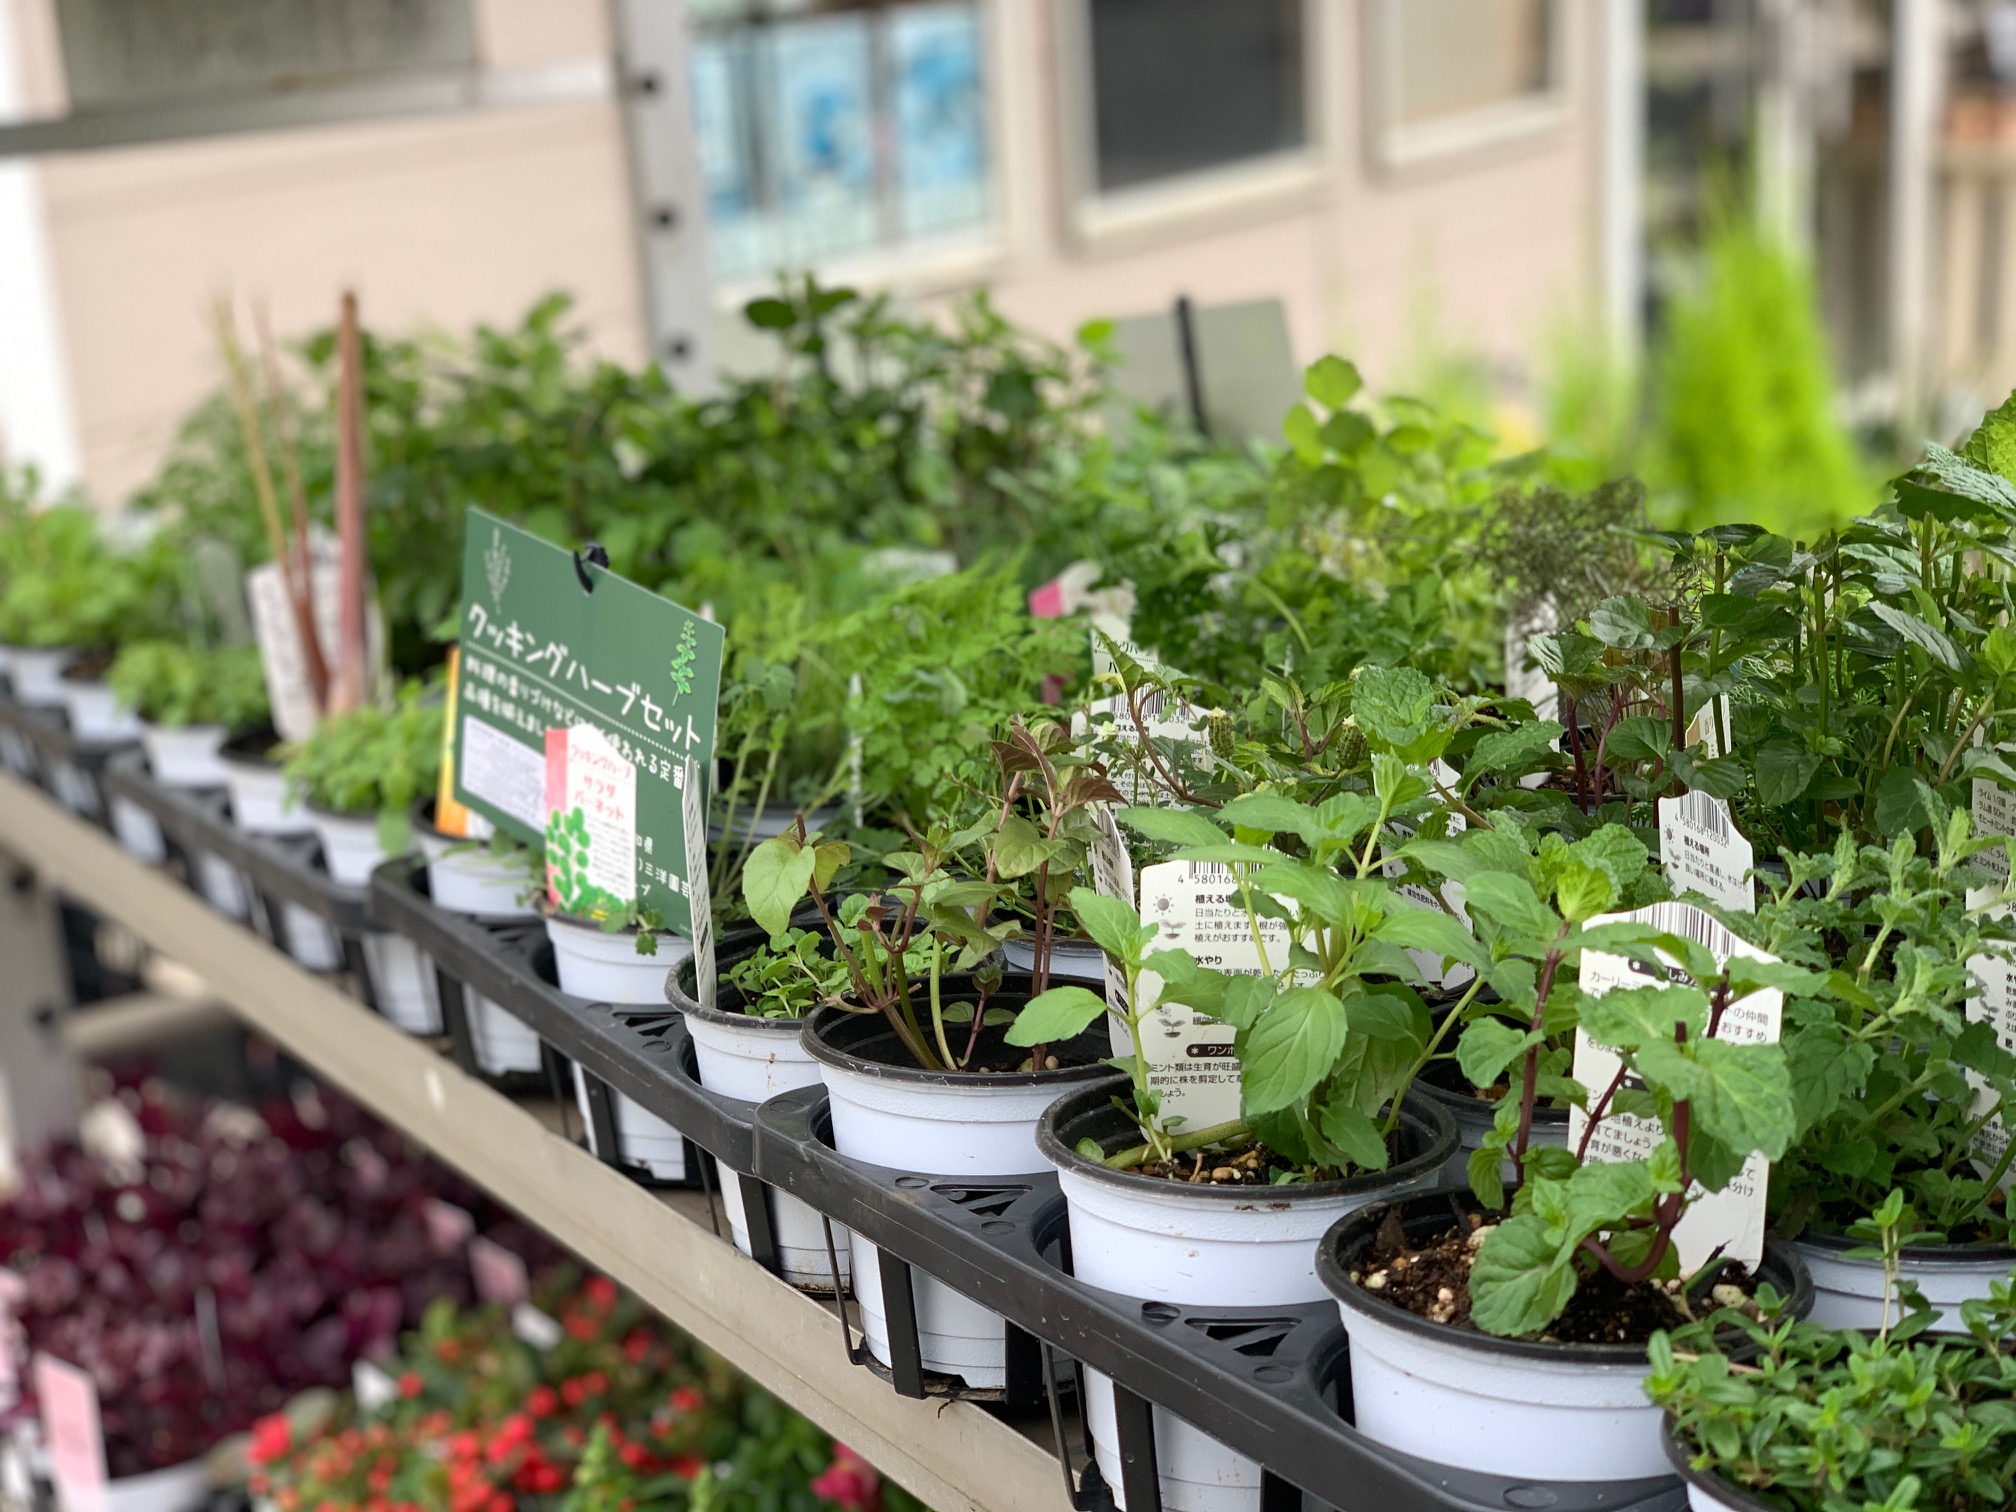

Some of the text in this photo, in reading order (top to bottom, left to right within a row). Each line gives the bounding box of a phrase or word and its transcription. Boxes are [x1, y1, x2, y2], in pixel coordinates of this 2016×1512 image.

[468, 602, 701, 751] クッキングハーブセット
[1684, 834, 1711, 858] 植える場所
[1177, 876, 1184, 884] 4
[1194, 921, 1287, 931] 土に植えます根が強
[1194, 956, 1223, 965] 水やり
[1721, 1020, 1768, 1043] おすすめ
[1580, 1137, 1648, 1163] 育が悪くな
